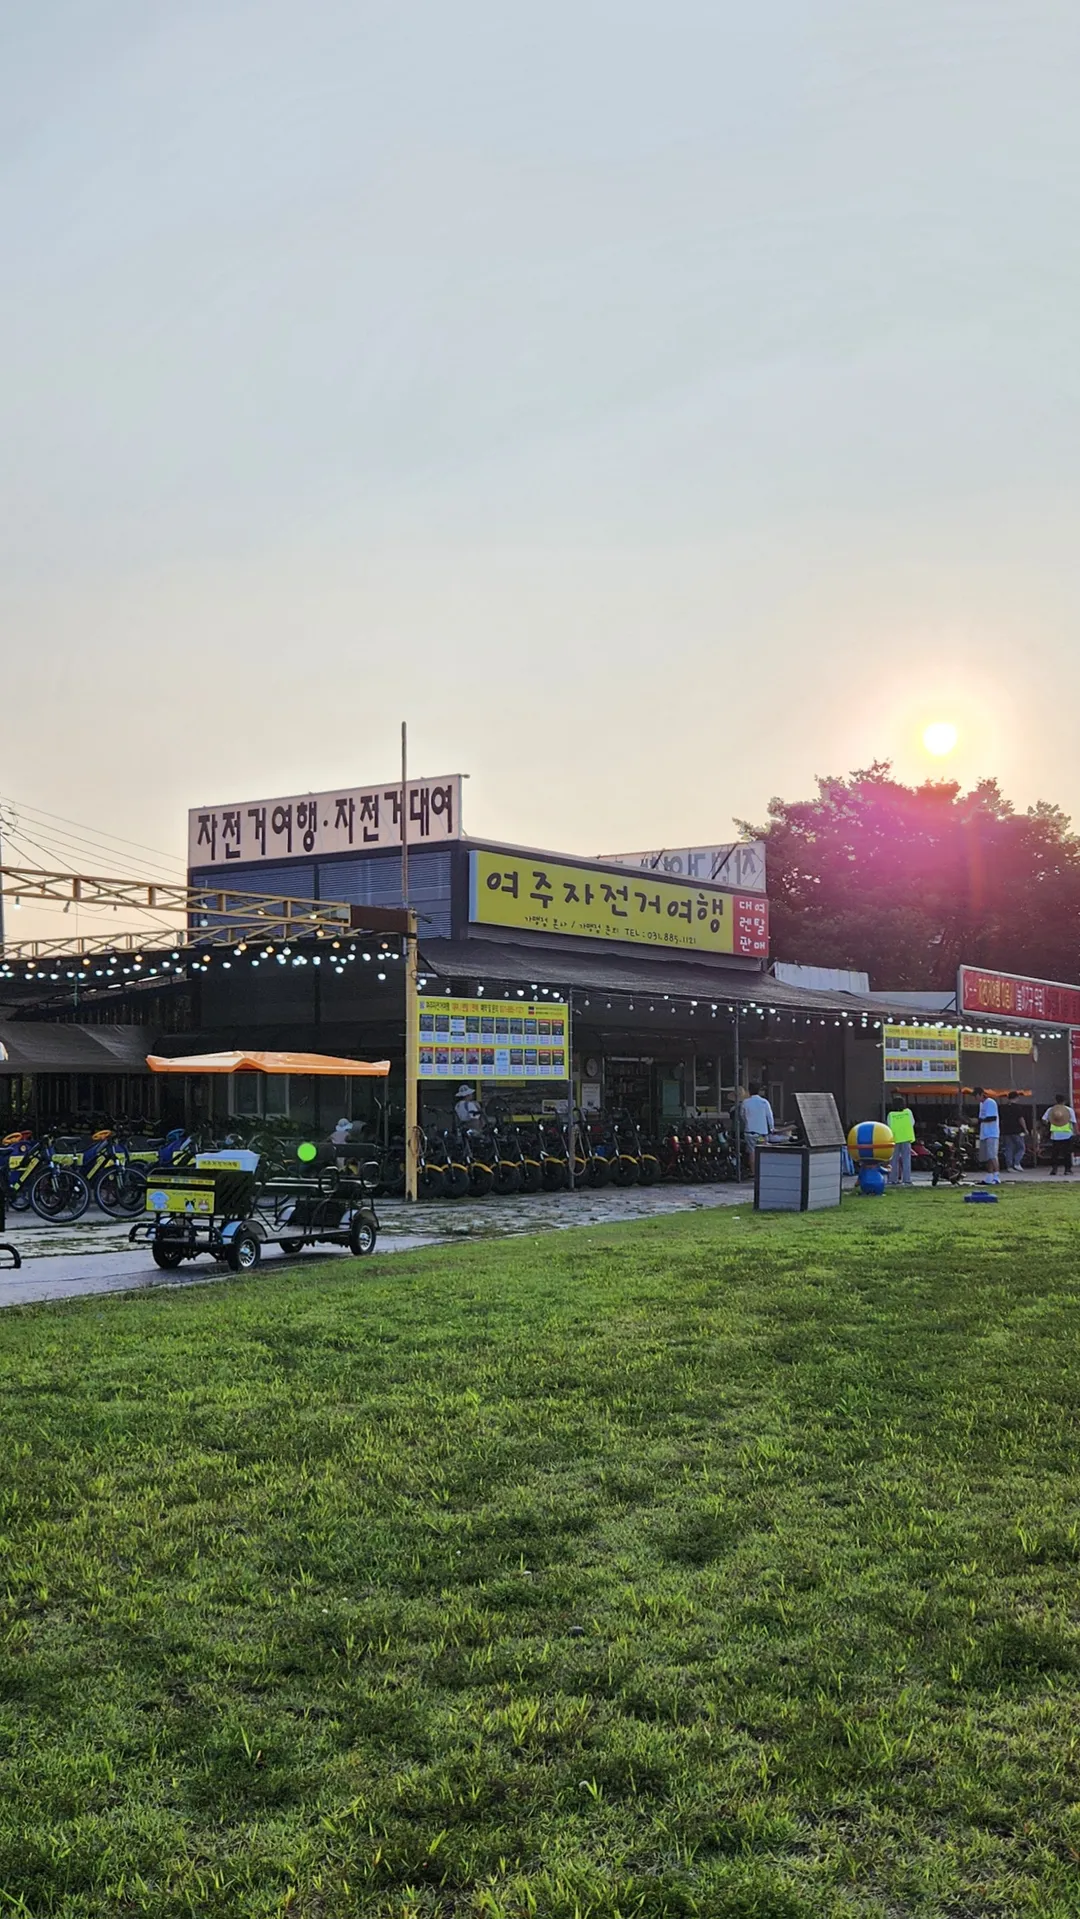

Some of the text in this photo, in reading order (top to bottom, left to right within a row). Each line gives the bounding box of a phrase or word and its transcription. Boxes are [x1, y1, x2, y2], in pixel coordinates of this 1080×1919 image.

[486, 871, 724, 933] 여주자전거여행
[739, 901, 765, 914] 대여
[739, 916, 765, 936] 렌탈
[739, 936, 766, 952] 판매
